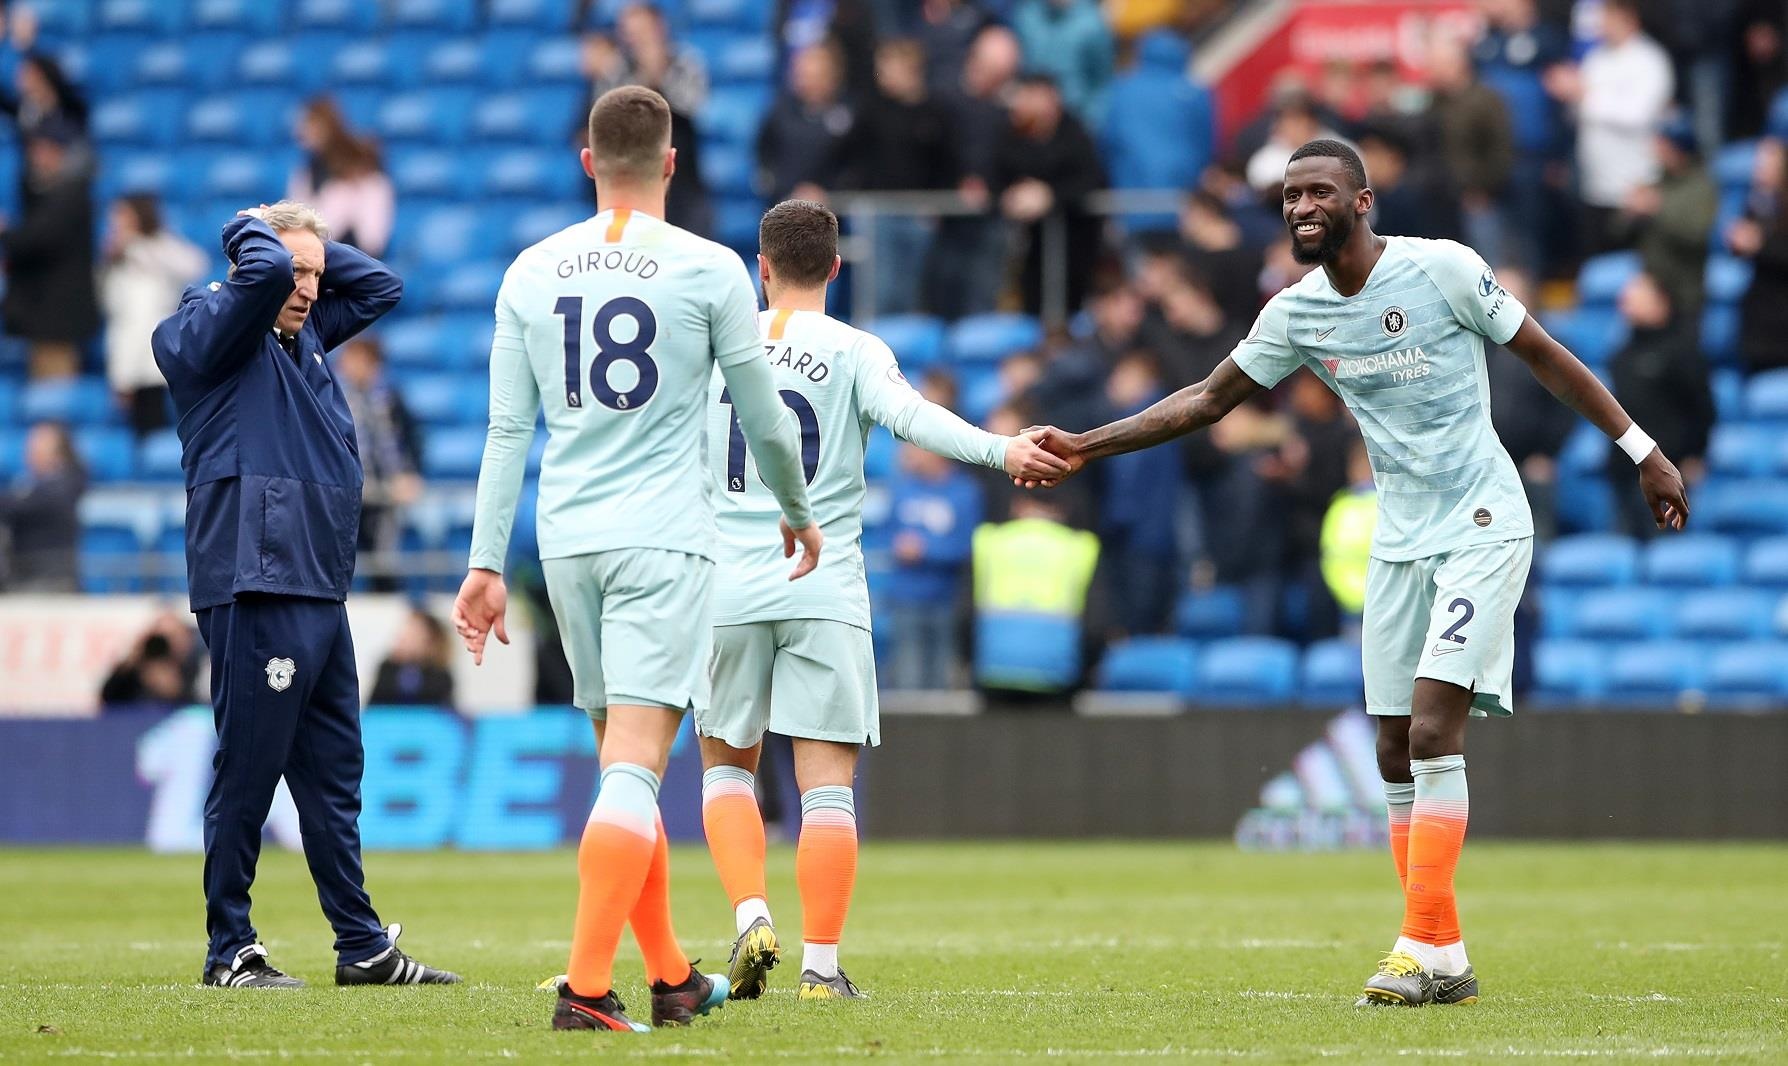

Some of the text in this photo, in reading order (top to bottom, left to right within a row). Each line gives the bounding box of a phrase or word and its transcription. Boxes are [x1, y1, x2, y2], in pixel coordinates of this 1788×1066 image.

[557, 250, 659, 279] GIROUD
[552, 295, 660, 411] 18
[764, 345, 829, 383] ZARD
[1340, 346, 1428, 376] YOKOHAMA
[1391, 363, 1430, 382] TYRES
[1440, 597, 1475, 645] 2
